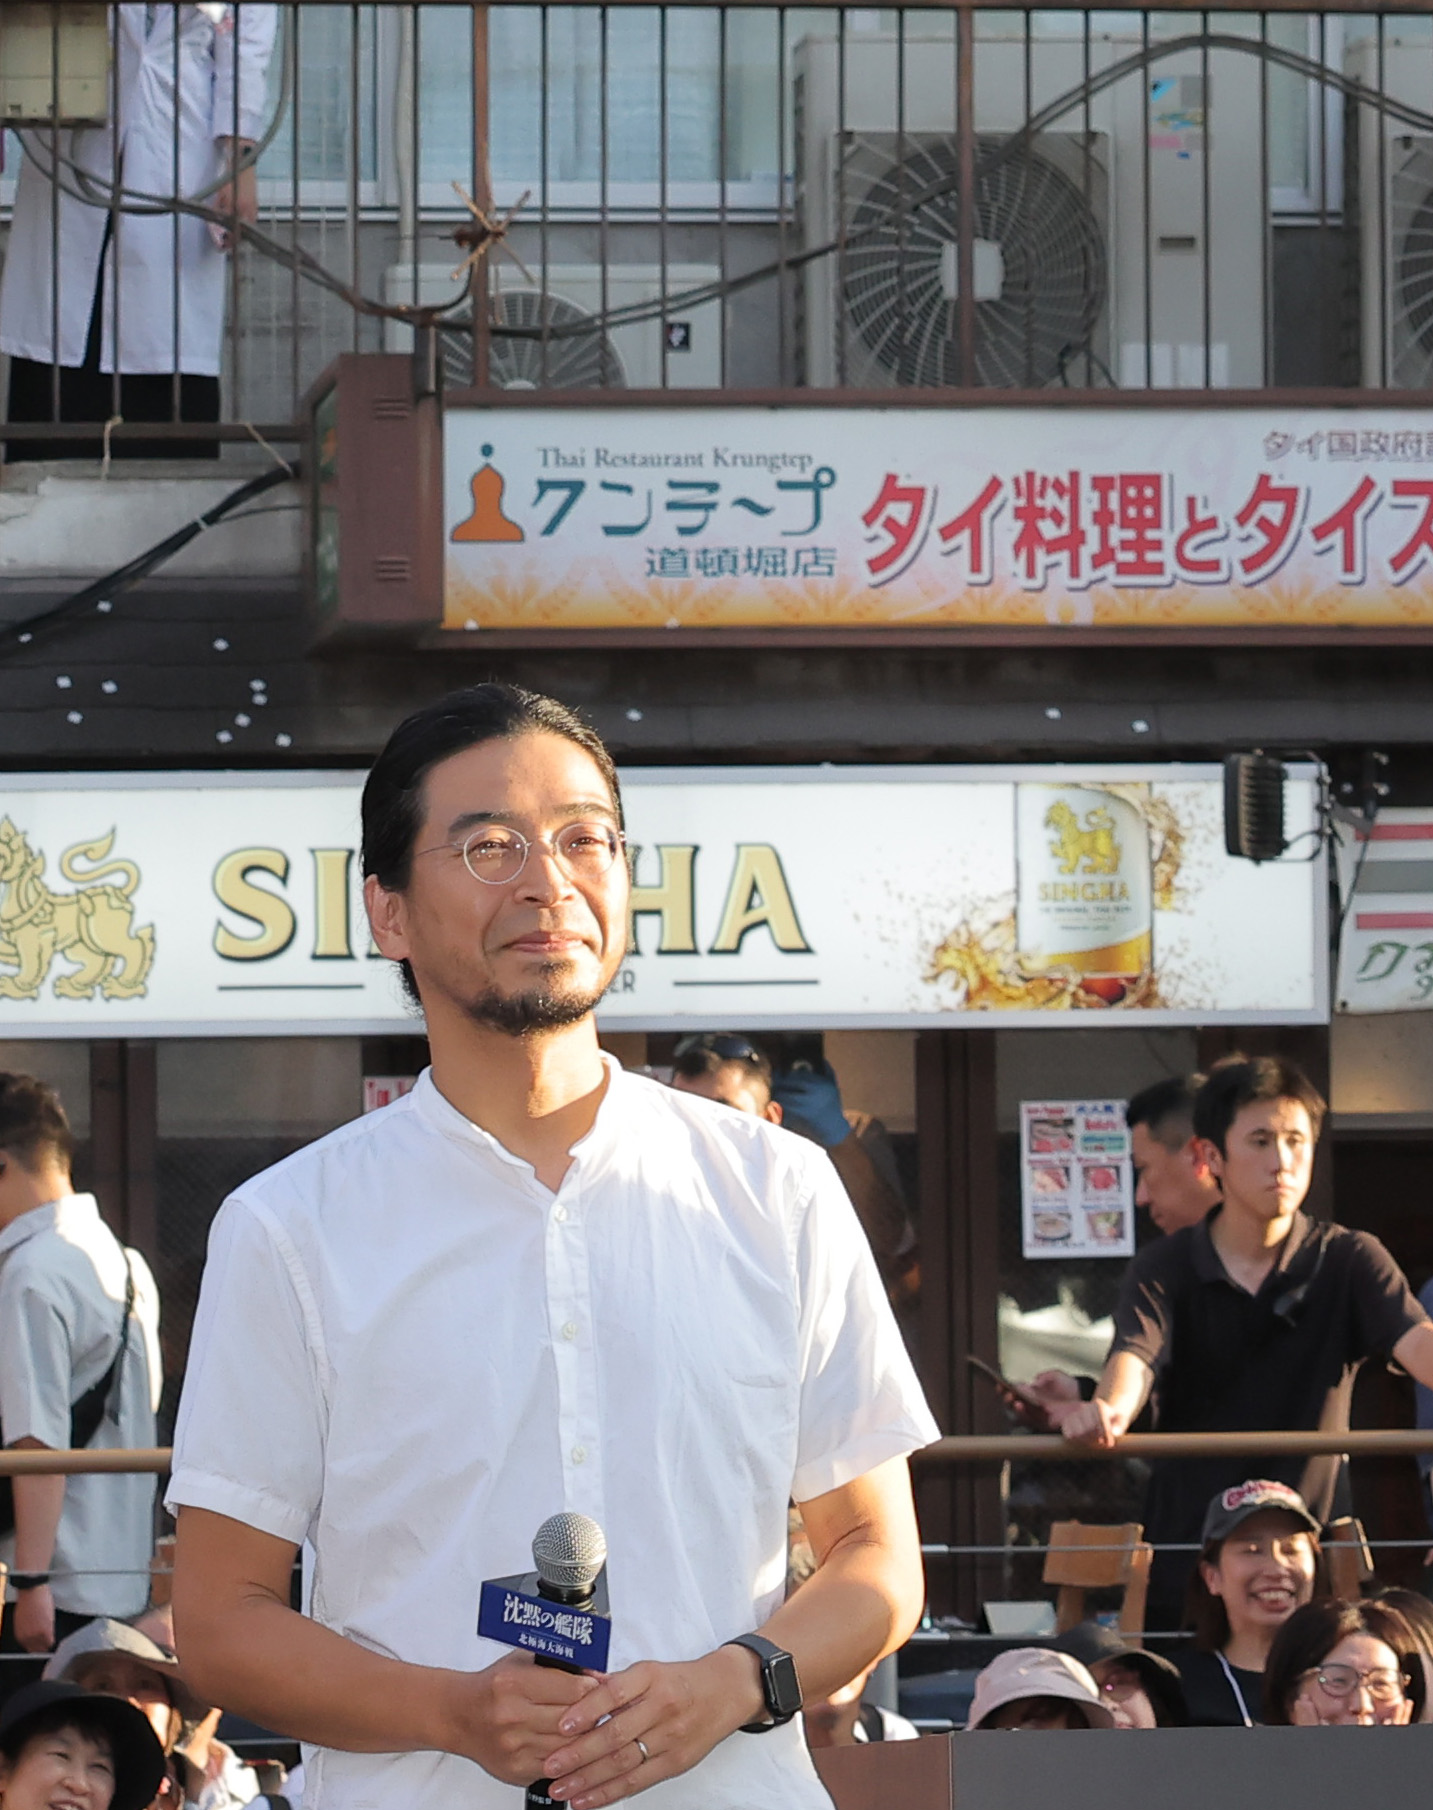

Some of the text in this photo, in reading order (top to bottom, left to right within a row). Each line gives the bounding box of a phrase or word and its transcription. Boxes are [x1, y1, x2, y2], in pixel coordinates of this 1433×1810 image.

[536, 447, 814, 474] Thai Restaurant Krungtep
[645, 546, 838, 579] 道頓堀店
[212, 842, 815, 960] SIHA
[503, 1592, 594, 1645] 沈黙の艦隊
